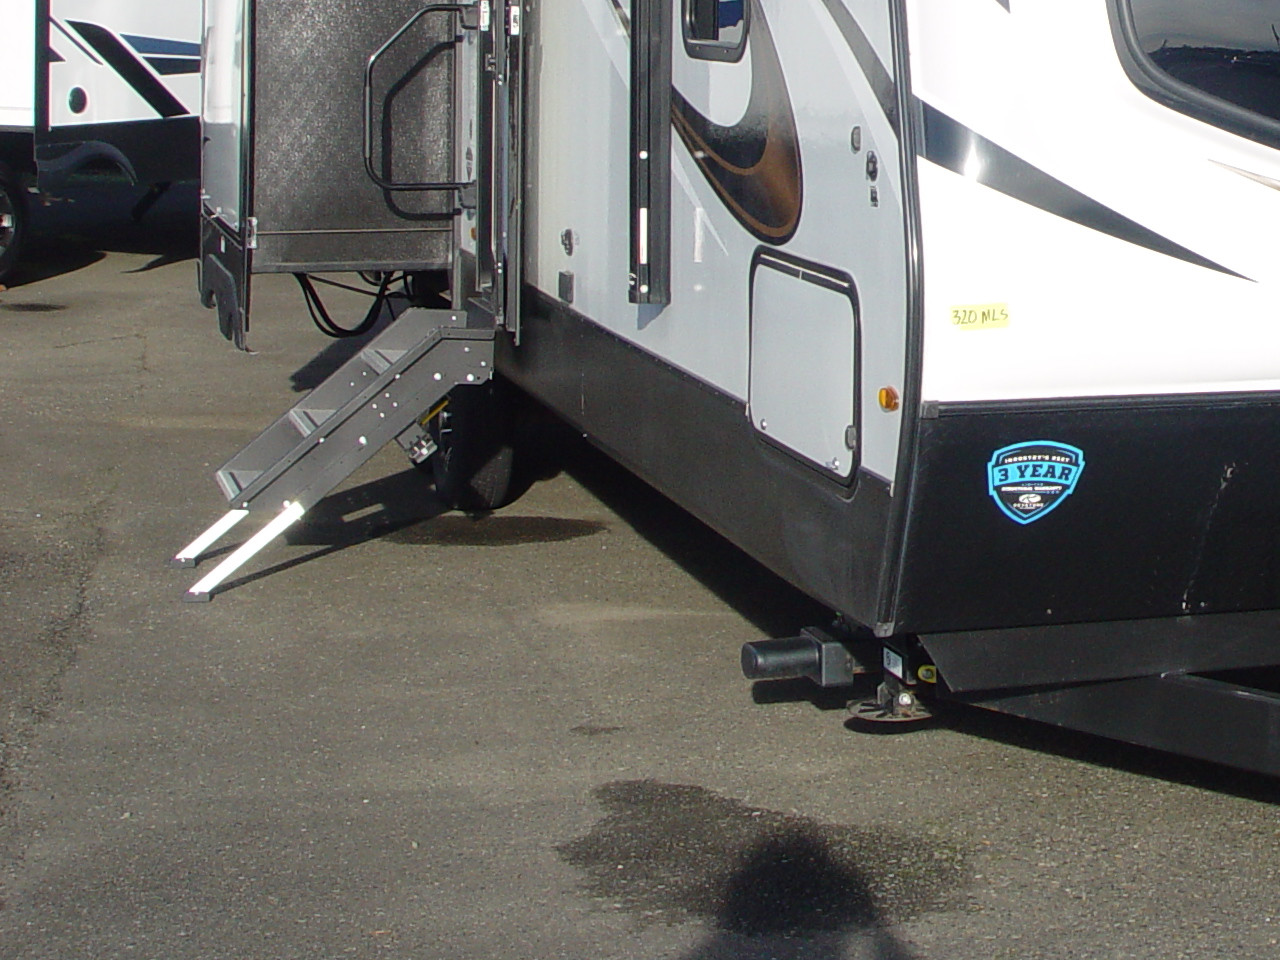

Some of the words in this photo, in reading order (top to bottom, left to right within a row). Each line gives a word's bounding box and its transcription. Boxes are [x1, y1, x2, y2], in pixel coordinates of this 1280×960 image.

[952, 309, 978, 325] 320
[998, 467, 1010, 482] 3
[1017, 463, 1073, 481] YEAR
